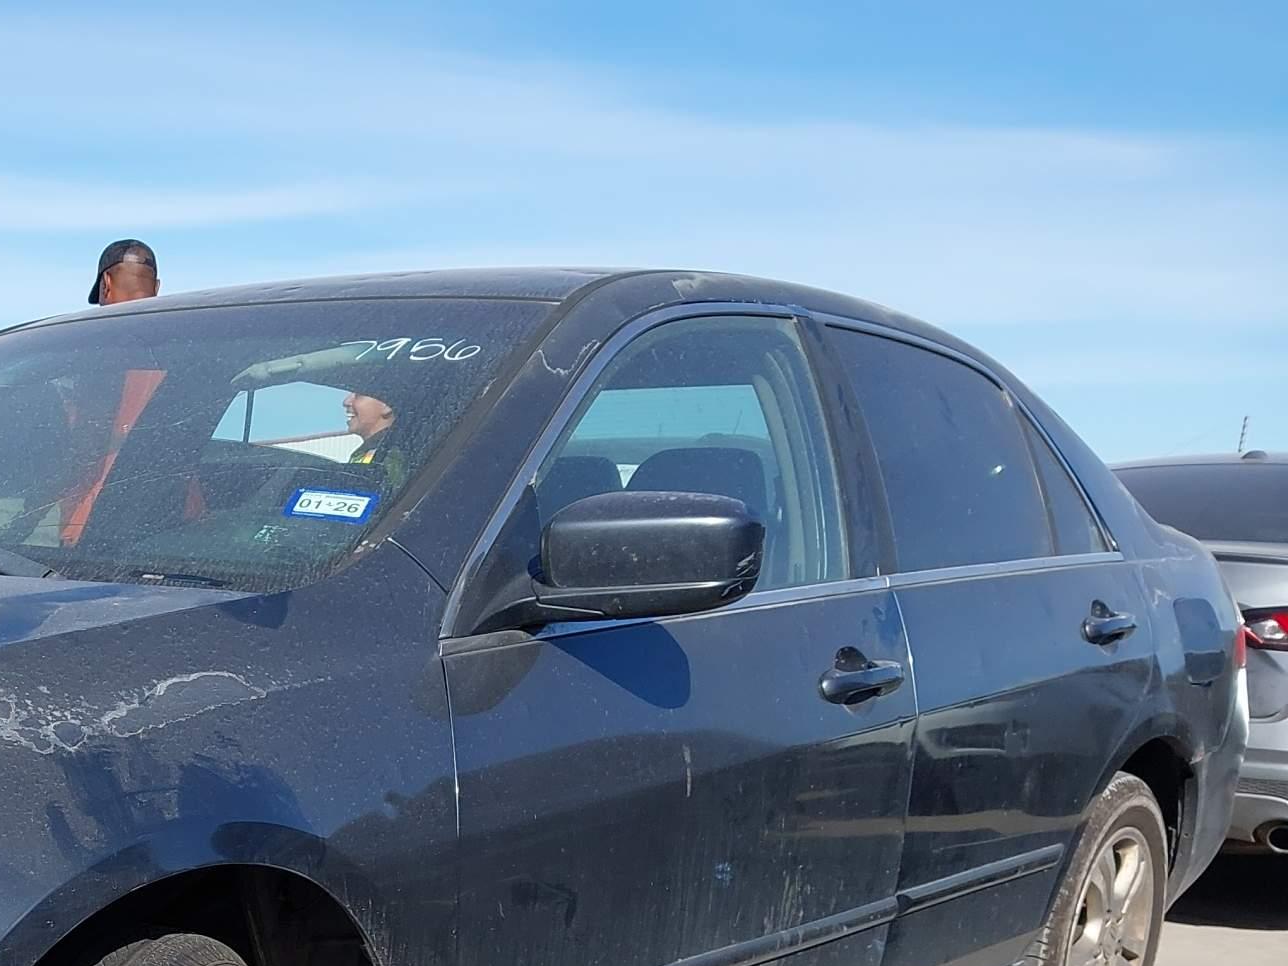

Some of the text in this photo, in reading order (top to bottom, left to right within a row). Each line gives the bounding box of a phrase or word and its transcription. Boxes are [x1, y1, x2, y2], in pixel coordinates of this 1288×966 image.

[340, 337, 481, 361] 7956
[298, 498, 361, 514] 01 26
